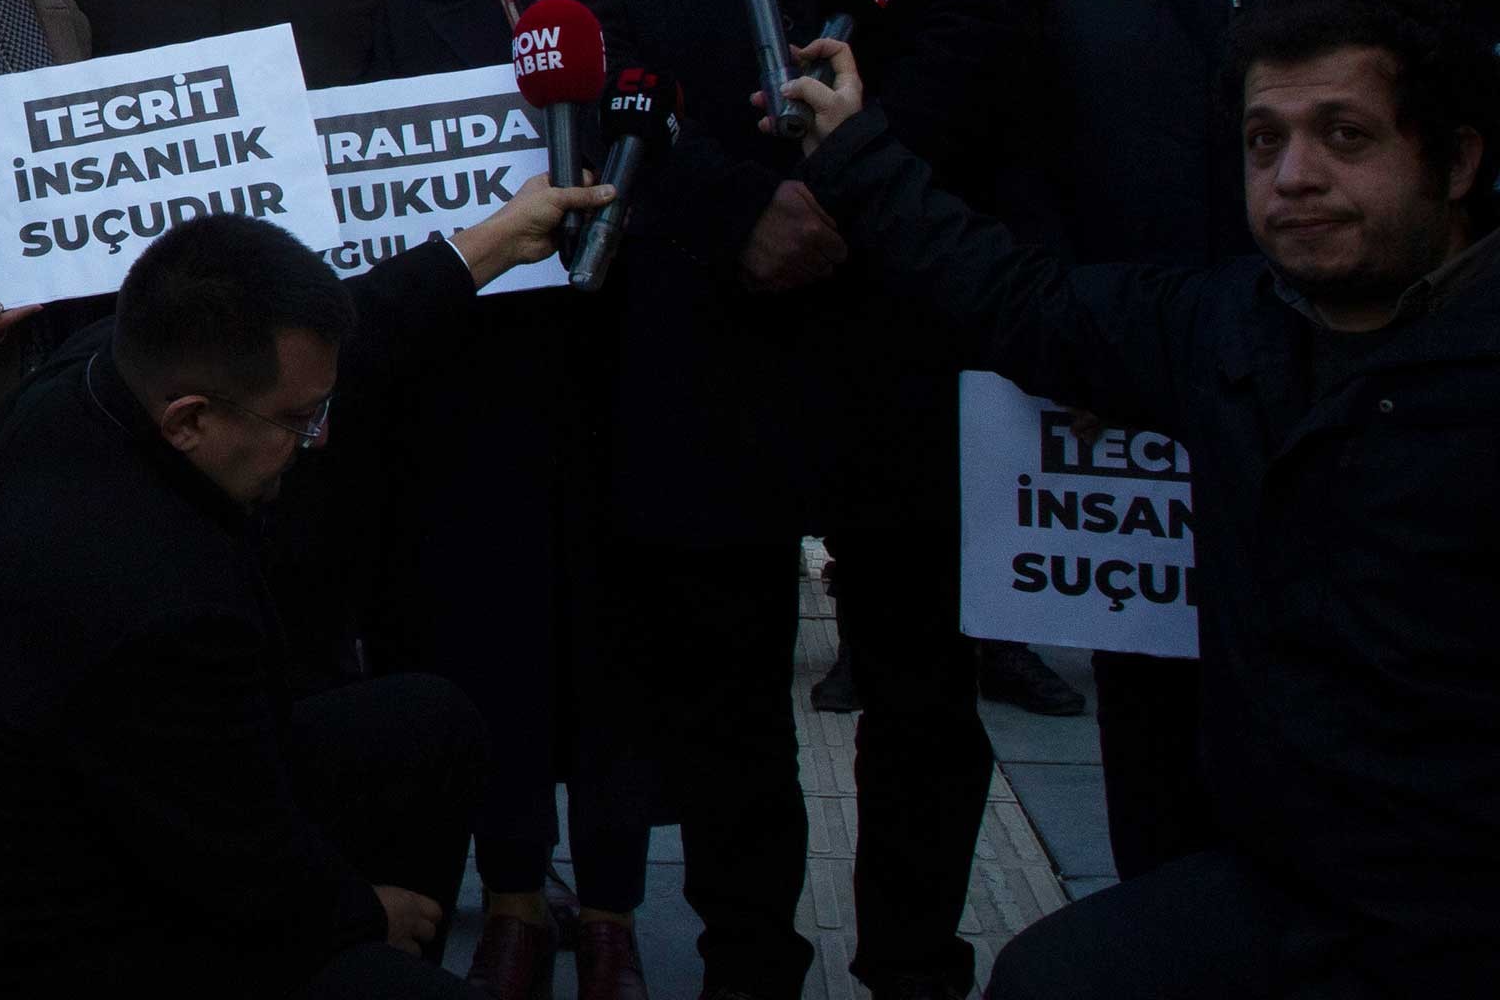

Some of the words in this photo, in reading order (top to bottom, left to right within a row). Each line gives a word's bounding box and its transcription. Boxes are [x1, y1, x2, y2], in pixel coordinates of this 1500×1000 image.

[515, 50, 565, 78] ABER
[33, 71, 227, 144] TECRİT
[319, 108, 541, 166] RALI'DA
[12, 125, 274, 204] İNSANLIK
[18, 181, 288, 258] SUÇUDUR
[1017, 474, 1197, 539] İNSAN
